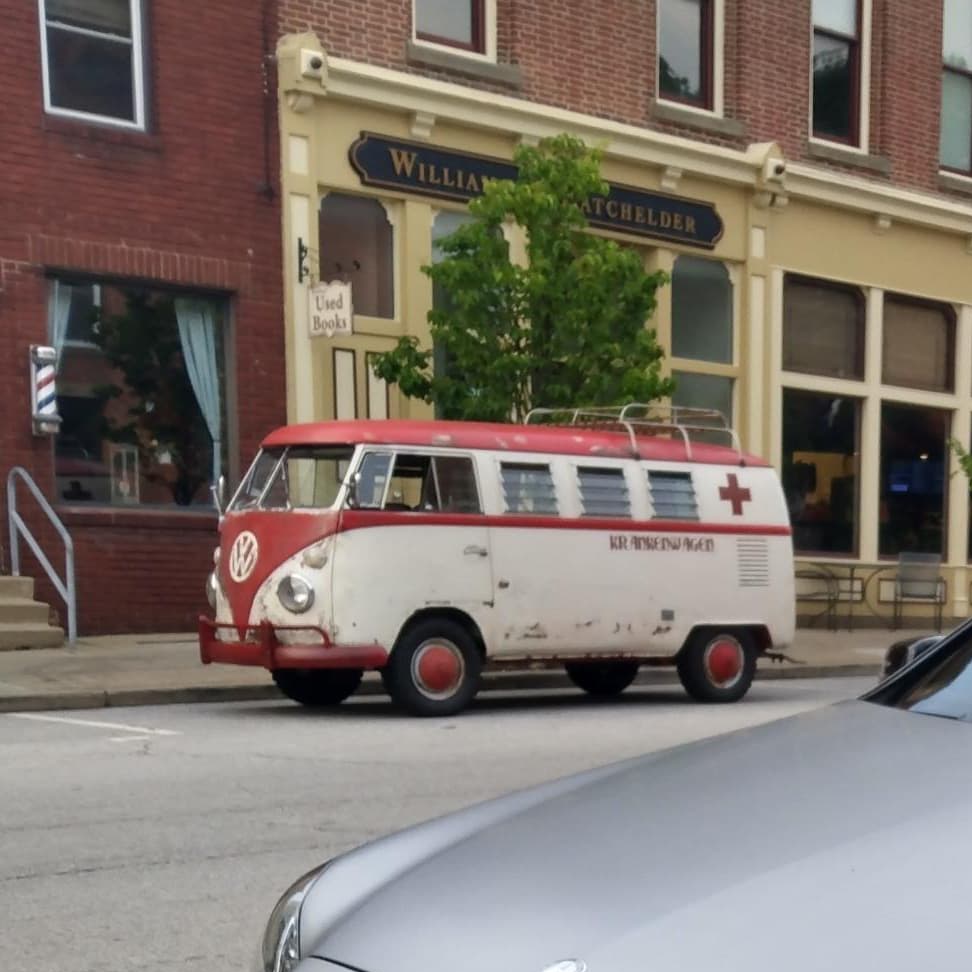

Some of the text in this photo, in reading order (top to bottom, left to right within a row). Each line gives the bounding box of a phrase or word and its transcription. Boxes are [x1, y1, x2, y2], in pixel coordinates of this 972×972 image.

[575, 197, 697, 233] ATCHELDER
[315, 292, 344, 312] Used
[313, 313, 347, 331] Books
